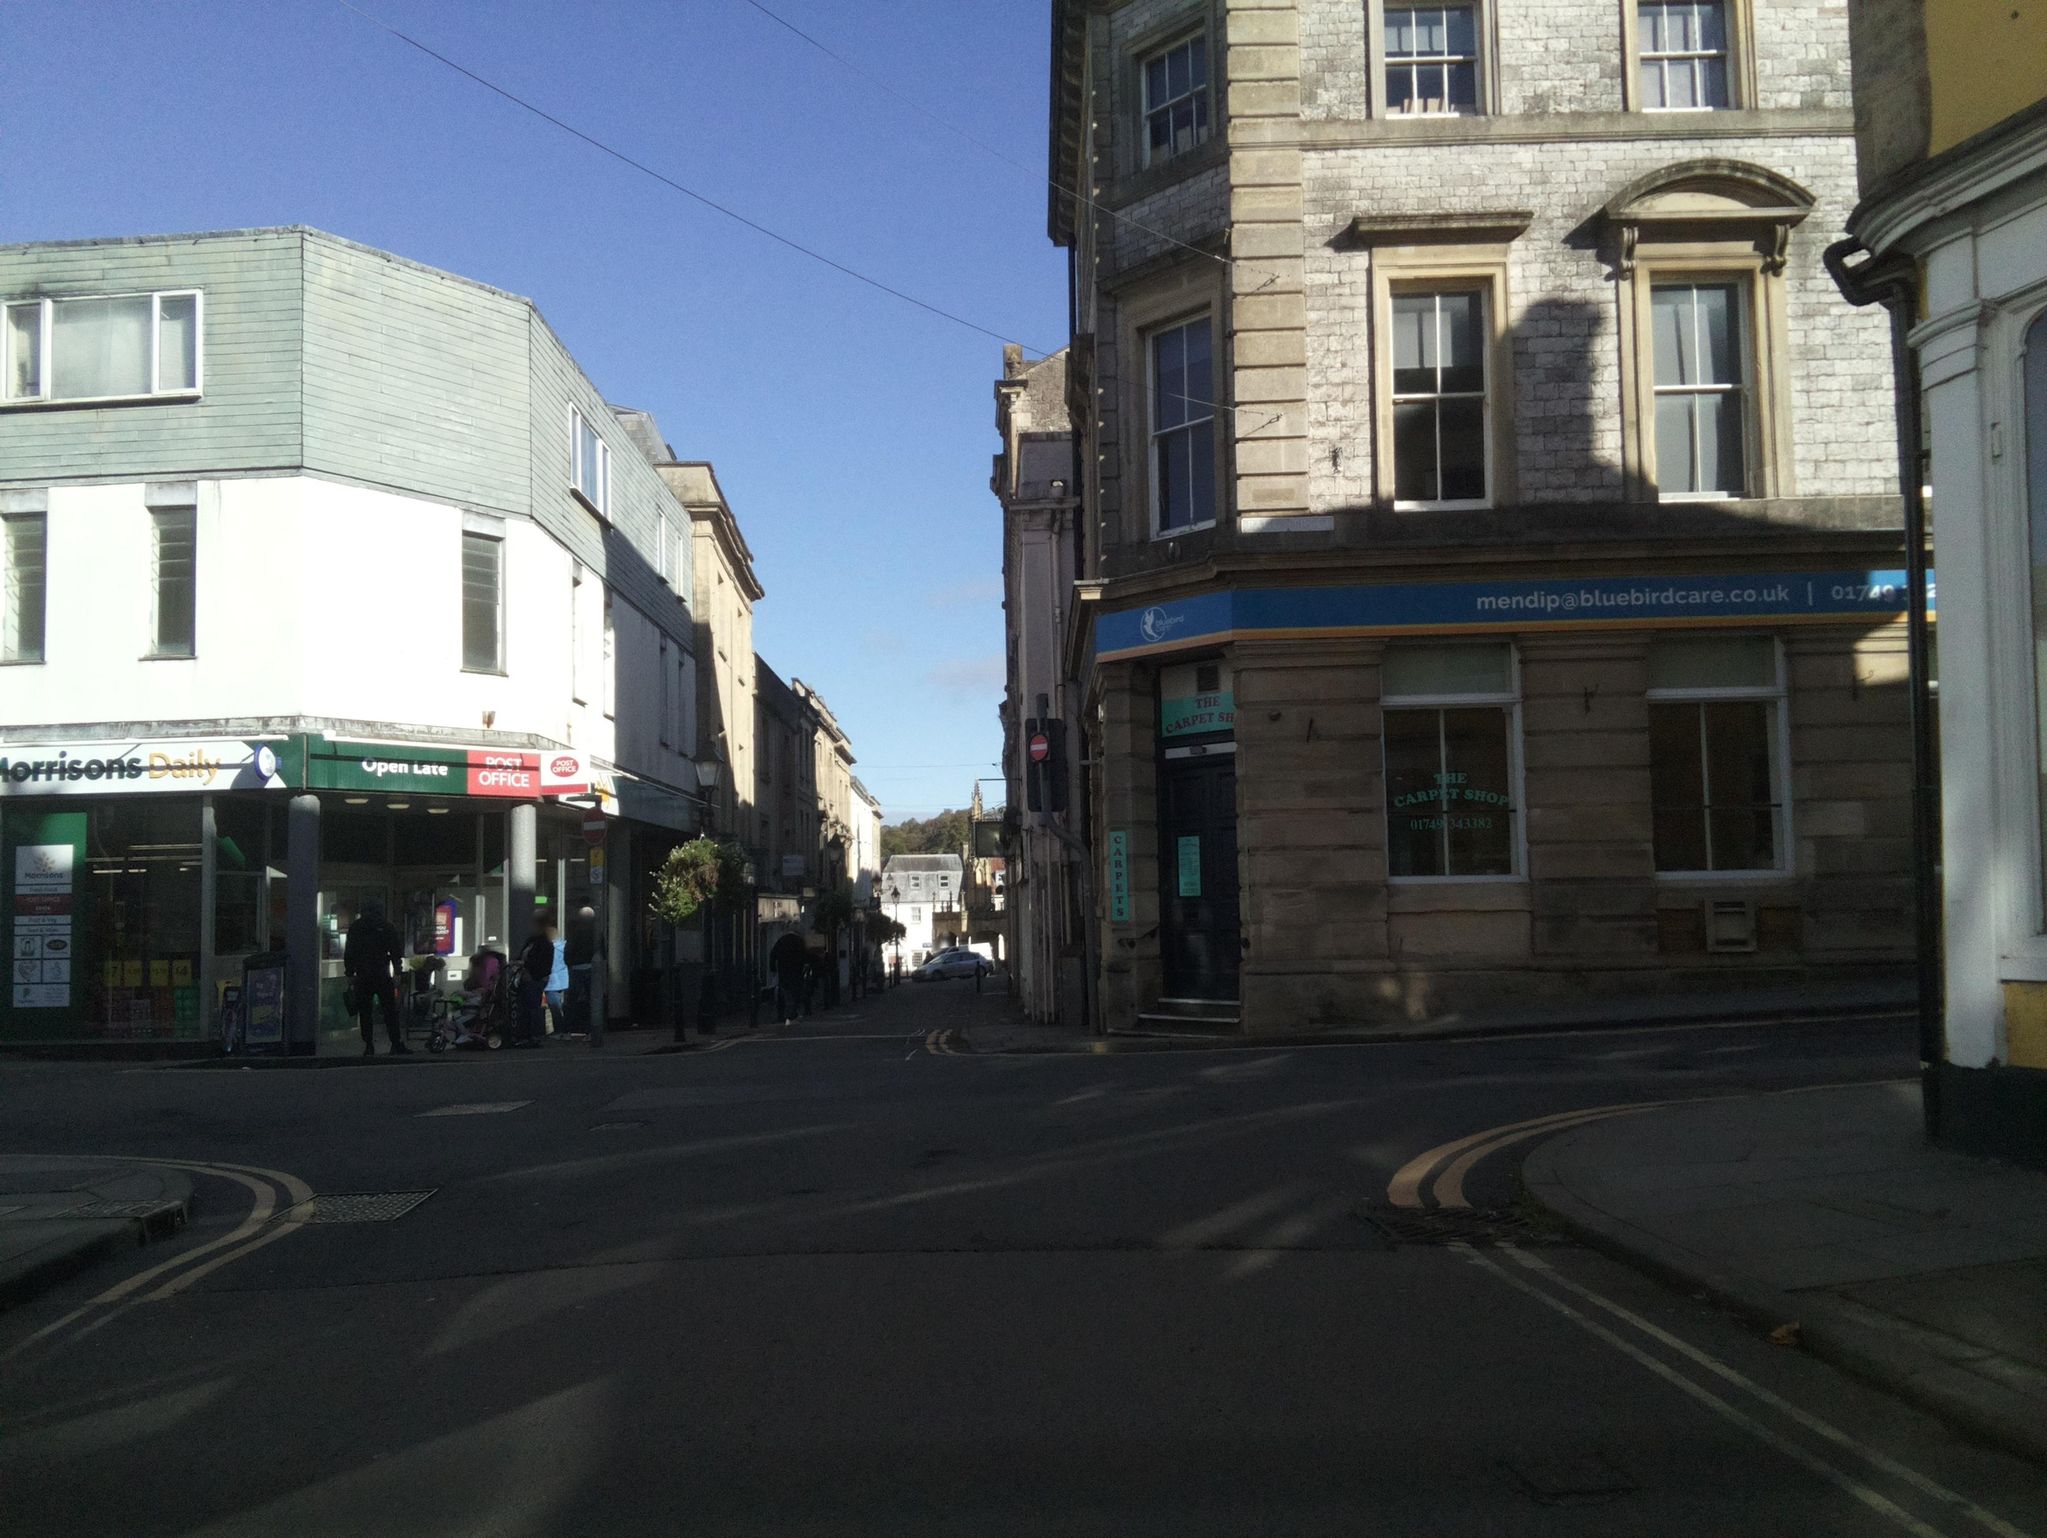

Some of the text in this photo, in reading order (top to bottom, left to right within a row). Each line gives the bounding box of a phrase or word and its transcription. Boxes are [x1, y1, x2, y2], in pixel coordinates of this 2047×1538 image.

[1476, 585, 1790, 613] mendip@bluebirdcare.co.uk
[1831, 584, 1895, 602] 01749
[1195, 696, 1220, 709] THE
[1167, 712, 1214, 736] CARPET
[0, 749, 221, 786] orrisons Daily
[362, 757, 448, 777] Open Late
[485, 756, 522, 773] POST
[553, 765, 577, 773] OFFICE
[479, 771, 530, 788] OFFICE
[1433, 773, 1468, 785] THE
[1394, 788, 1509, 808] CARPET SHOP
[1114, 836, 1124, 917] CARPETS
